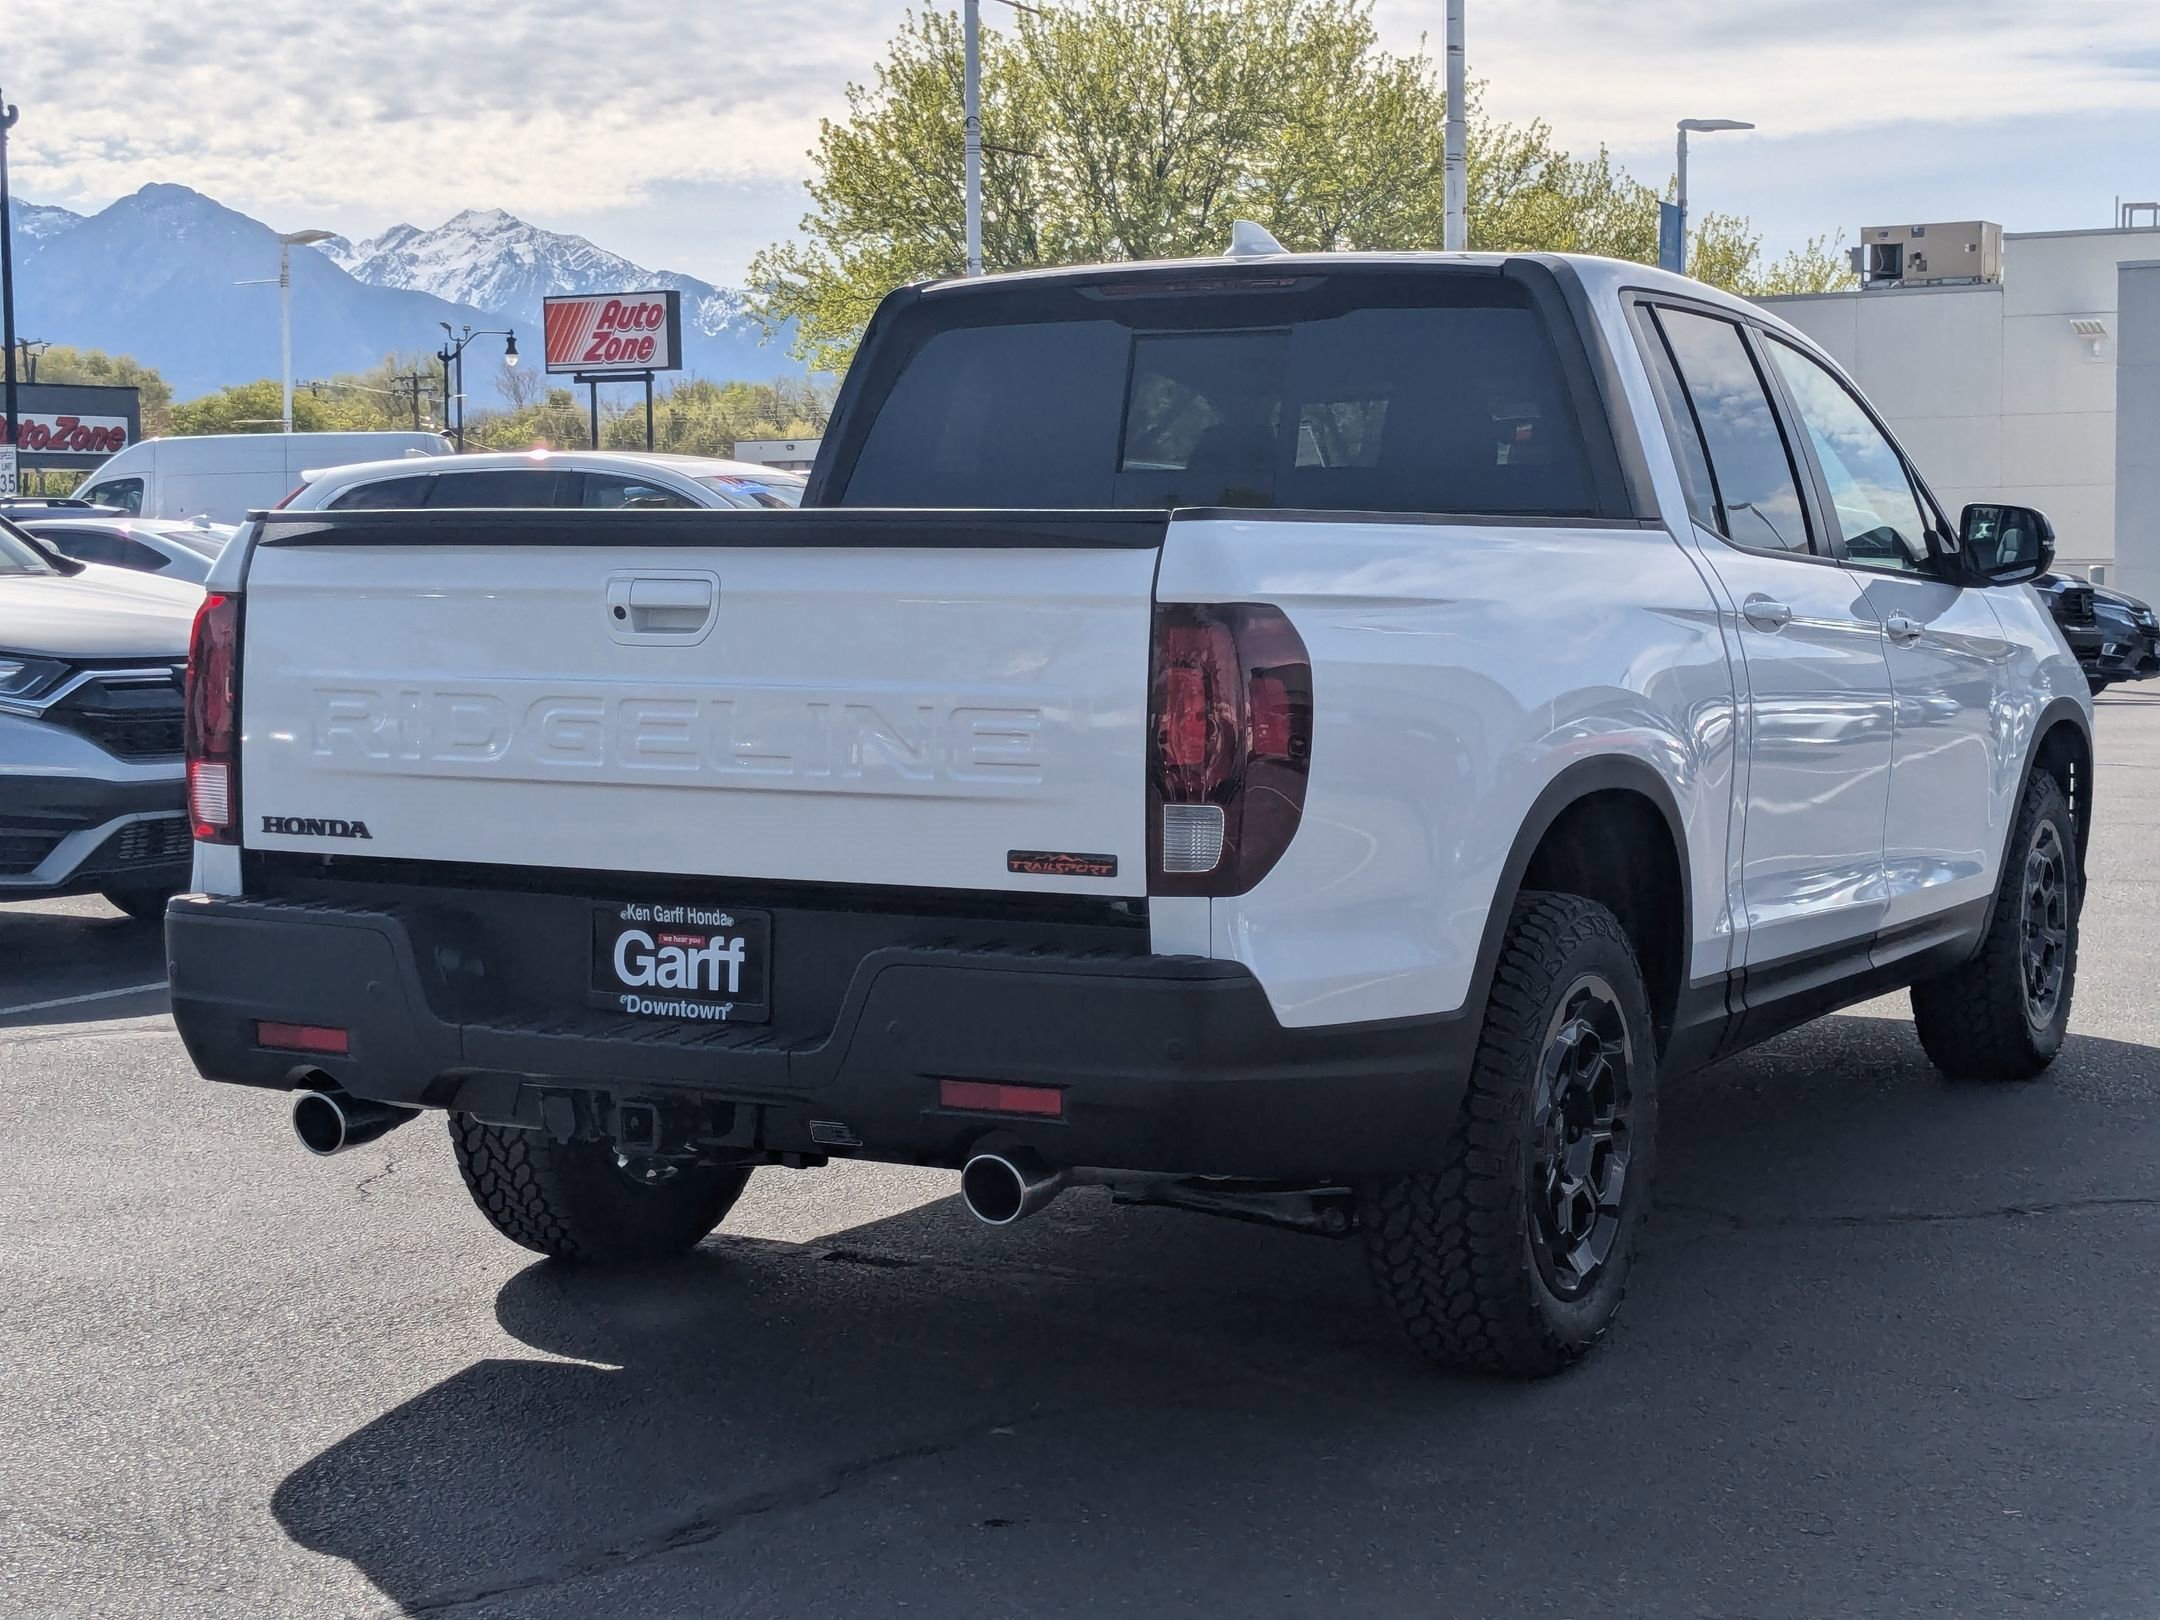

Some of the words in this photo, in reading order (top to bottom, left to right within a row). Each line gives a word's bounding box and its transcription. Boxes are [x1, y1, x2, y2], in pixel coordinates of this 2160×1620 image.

[596, 300, 665, 331] Auto
[583, 331, 656, 363] Zone
[0, 415, 126, 452] toZone
[0, 474, 16, 493] 35
[311, 688, 1043, 784] RIDGELINE
[261, 816, 373, 839] HONDA
[627, 904, 650, 921] Ken
[653, 905, 684, 924] Garff
[687, 907, 728, 927] Honda
[613, 929, 745, 993] Garff
[626, 994, 727, 1021] Downtown
